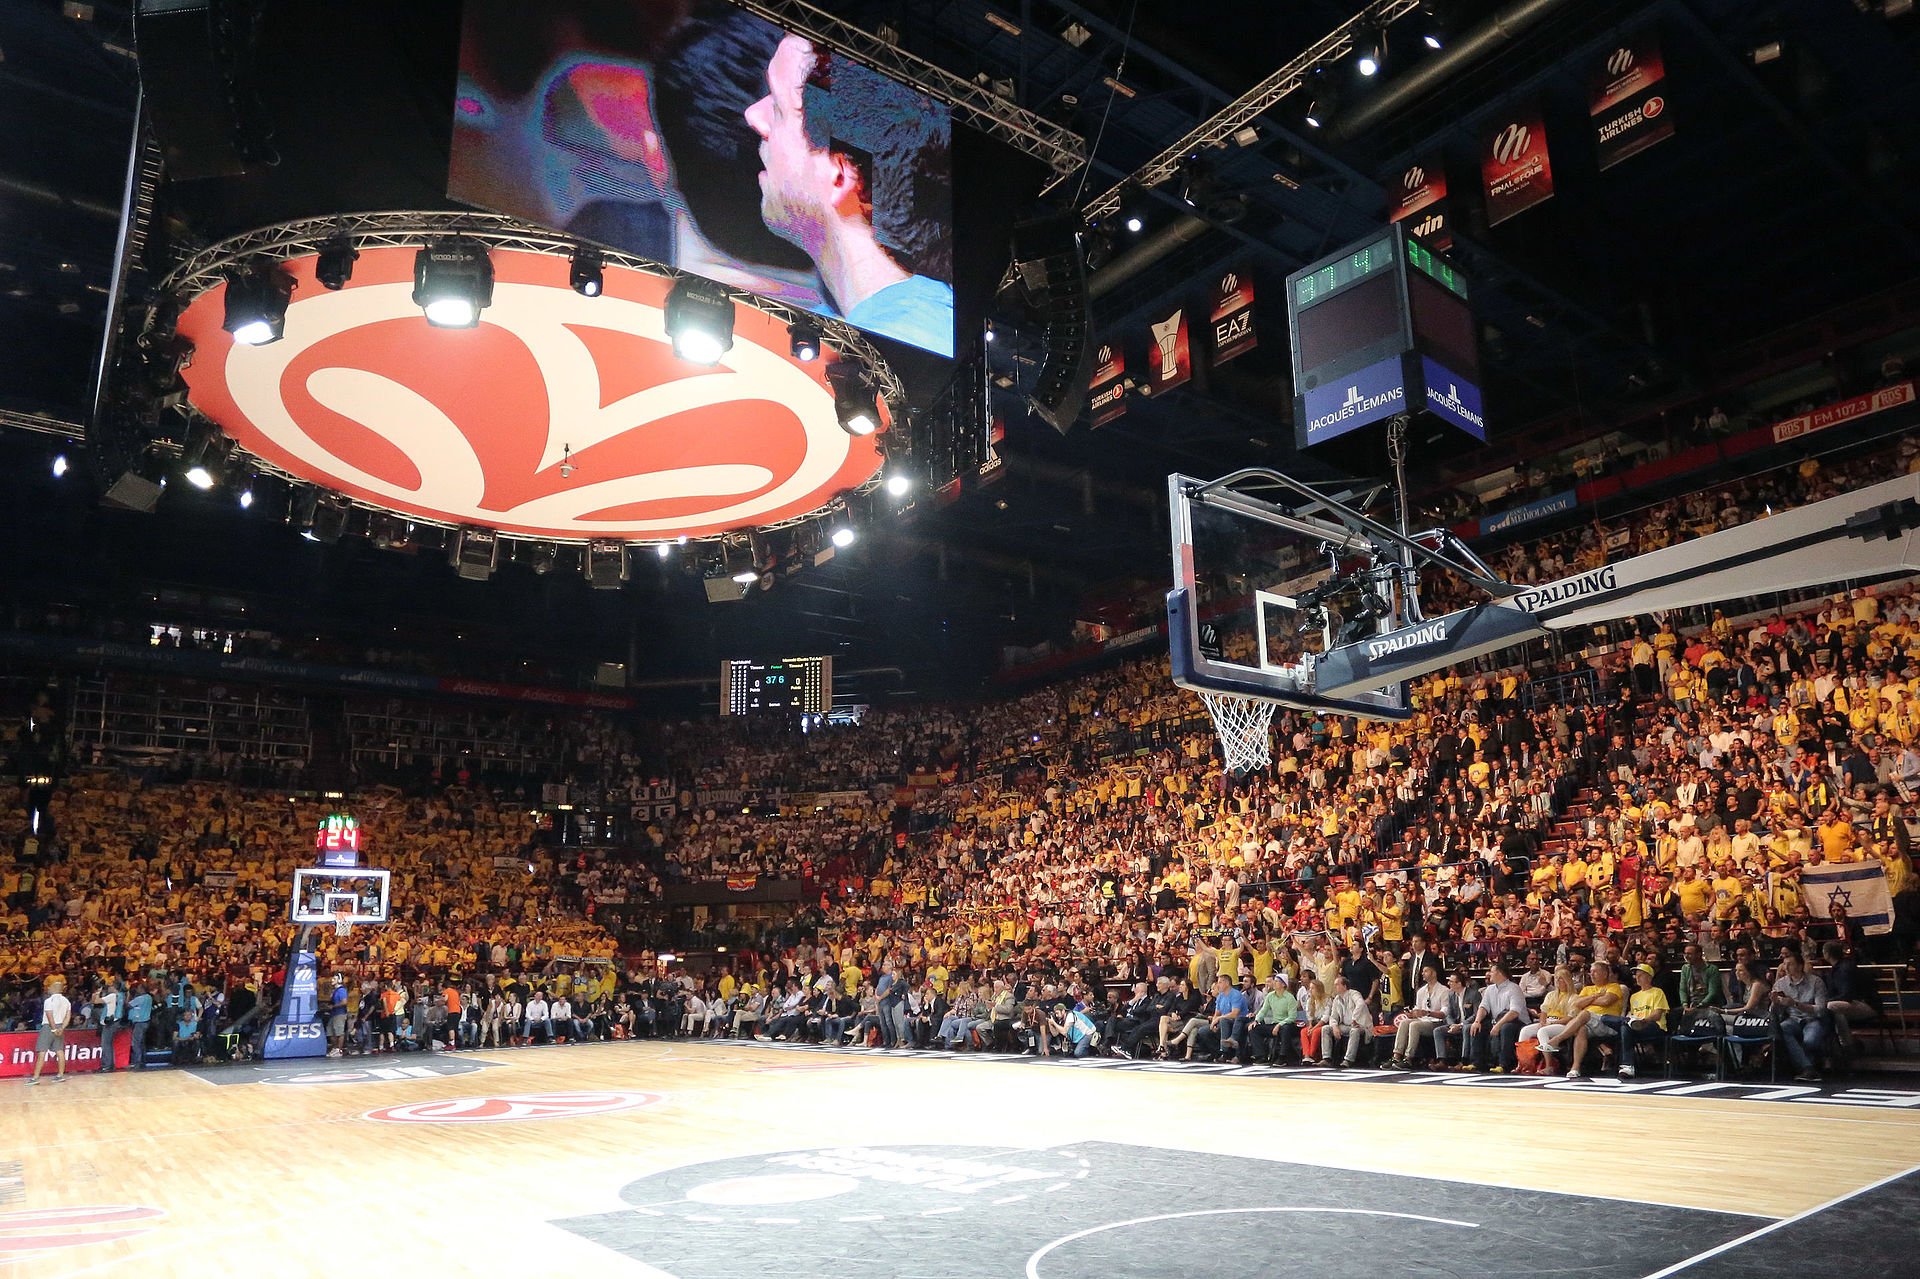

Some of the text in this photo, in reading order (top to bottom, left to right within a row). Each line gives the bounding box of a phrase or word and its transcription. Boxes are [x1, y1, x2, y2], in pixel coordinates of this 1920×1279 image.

[1598, 106, 1642, 135] TURKISH
[1600, 114, 1643, 143] AIRLINES
[1491, 164, 1543, 197] FINAL FOUR
[1216, 310, 1251, 343] EA7
[1309, 387, 1404, 433] JACQUES LEMANS
[1427, 387, 1485, 428] JACQUES LEMANS
[1814, 411, 1833, 425] FM
[1836, 400, 1868, 418] 107.3
[1881, 387, 1903, 405] RDS
[979, 457, 1003, 475] adidas
[1510, 500, 1567, 525] MEDIOLANUM
[1514, 566, 1617, 613] SPALDING
[1368, 621, 1446, 662] SPALDING
[453, 681, 499, 696] Adecco
[766, 675, 785, 684] 37 6
[327, 829, 357, 848] 24
[274, 1023, 321, 1040] EFES
[13, 1048, 34, 1064] in
[45, 1045, 103, 1062] Milan
